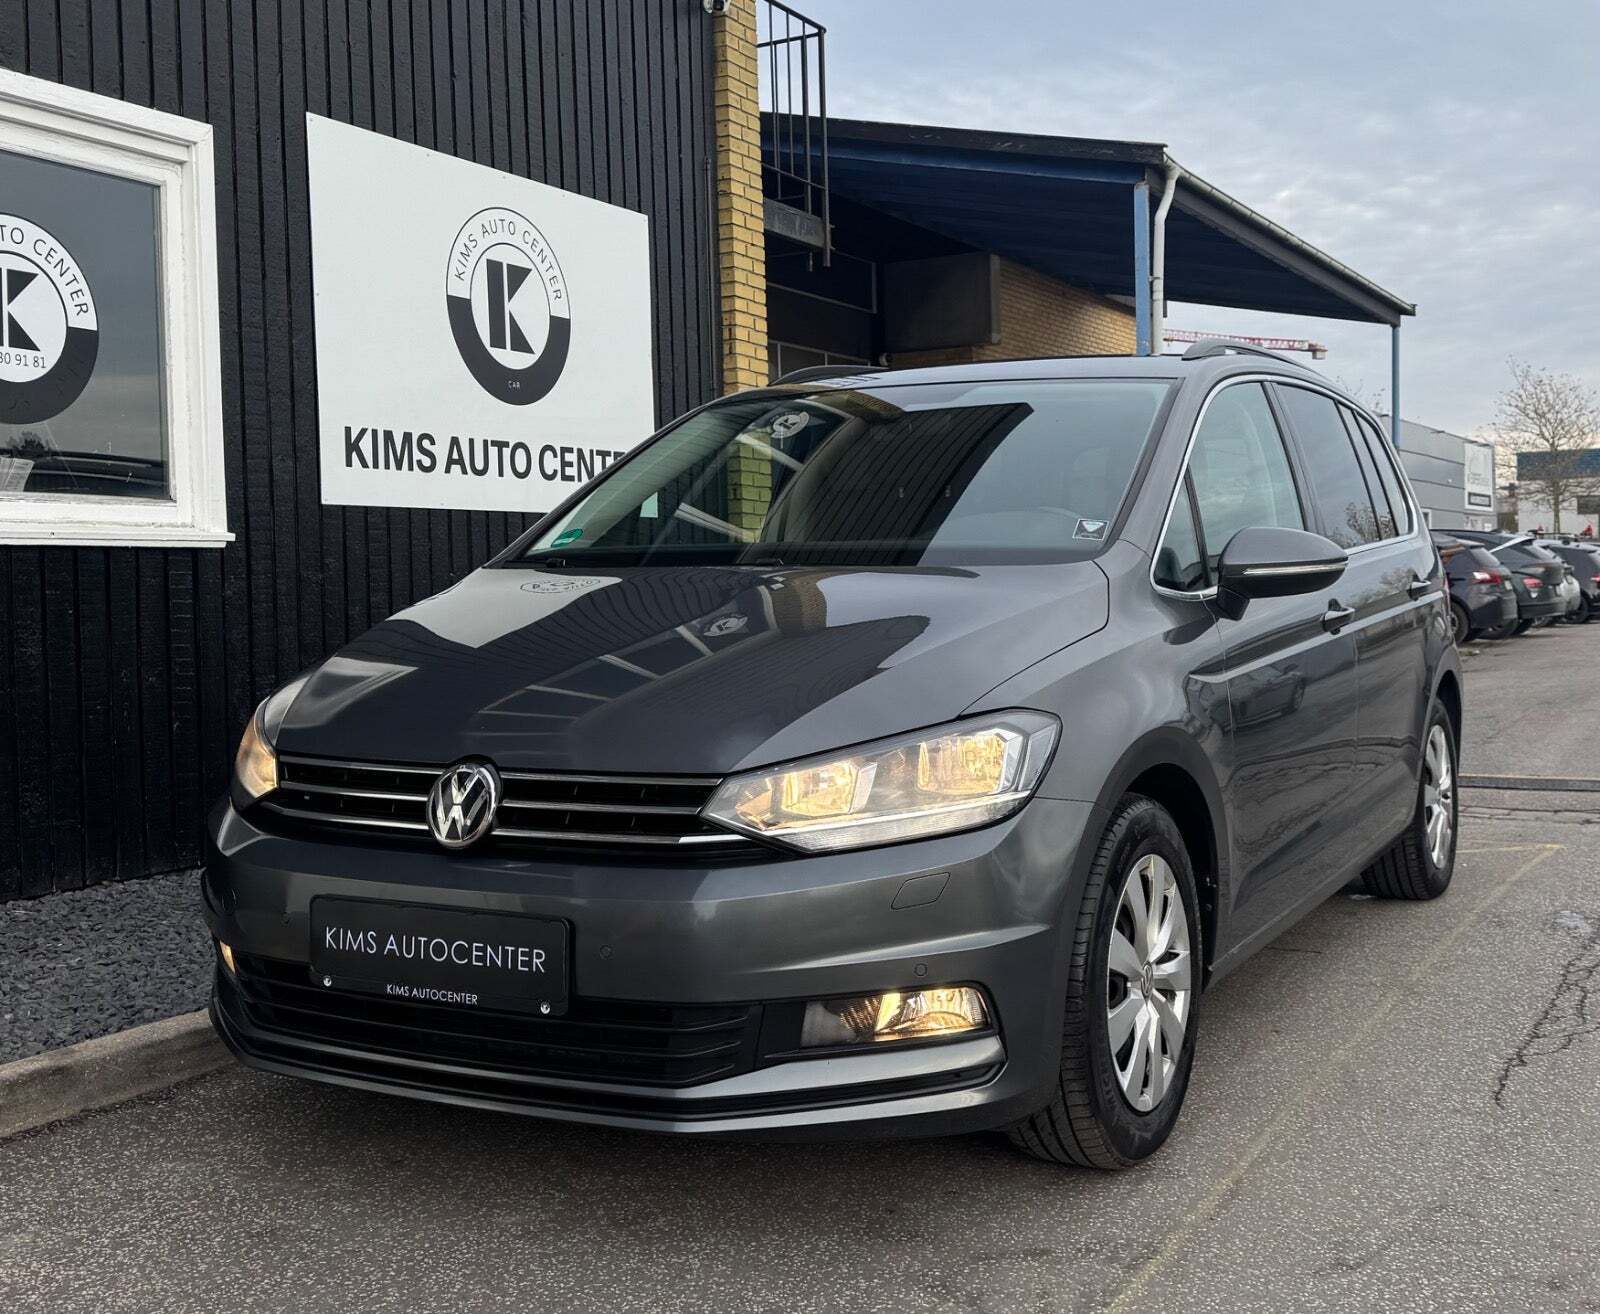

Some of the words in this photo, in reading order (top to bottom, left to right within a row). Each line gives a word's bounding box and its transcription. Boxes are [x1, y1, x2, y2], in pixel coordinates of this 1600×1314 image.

[33, 238, 89, 316] CENTER
[454, 233, 478, 281] KIMS
[480, 219, 516, 239] AUTO
[522, 230, 562, 301] CENTER
[486, 258, 534, 355] K
[15, 353, 29, 367] 91
[33, 355, 46, 369] 81
[344, 426, 437, 473] KIMS
[444, 436, 532, 479] AUTO
[326, 926, 377, 954] KIMS
[383, 933, 546, 973] AUTOCENTER
[386, 984, 410, 997] KIMS
[411, 987, 478, 1005] AUTOCENTER
